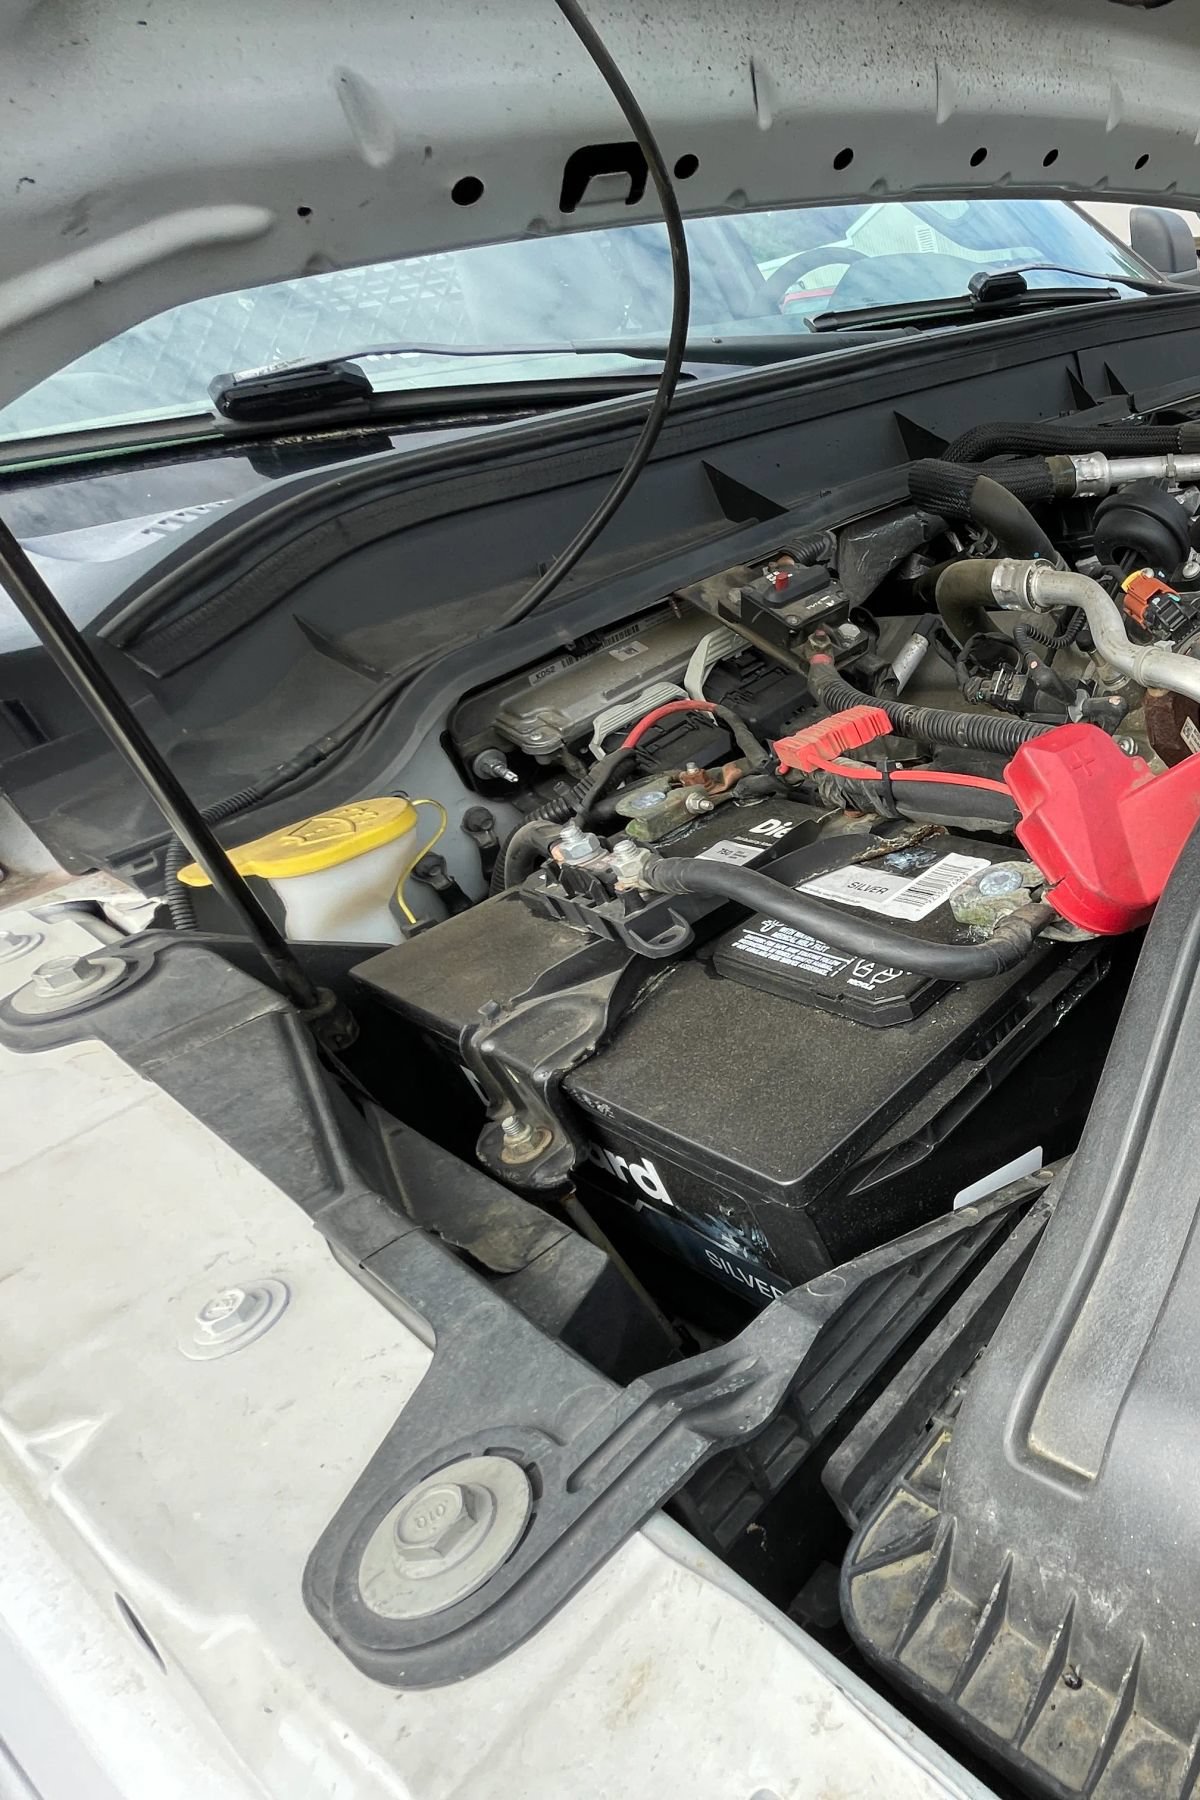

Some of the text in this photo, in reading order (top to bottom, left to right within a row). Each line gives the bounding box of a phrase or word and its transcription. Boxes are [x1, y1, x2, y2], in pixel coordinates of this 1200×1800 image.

[748, 818, 794, 839] Die
[846, 880, 889, 896] SILVER
[588, 1142, 675, 1207] ard
